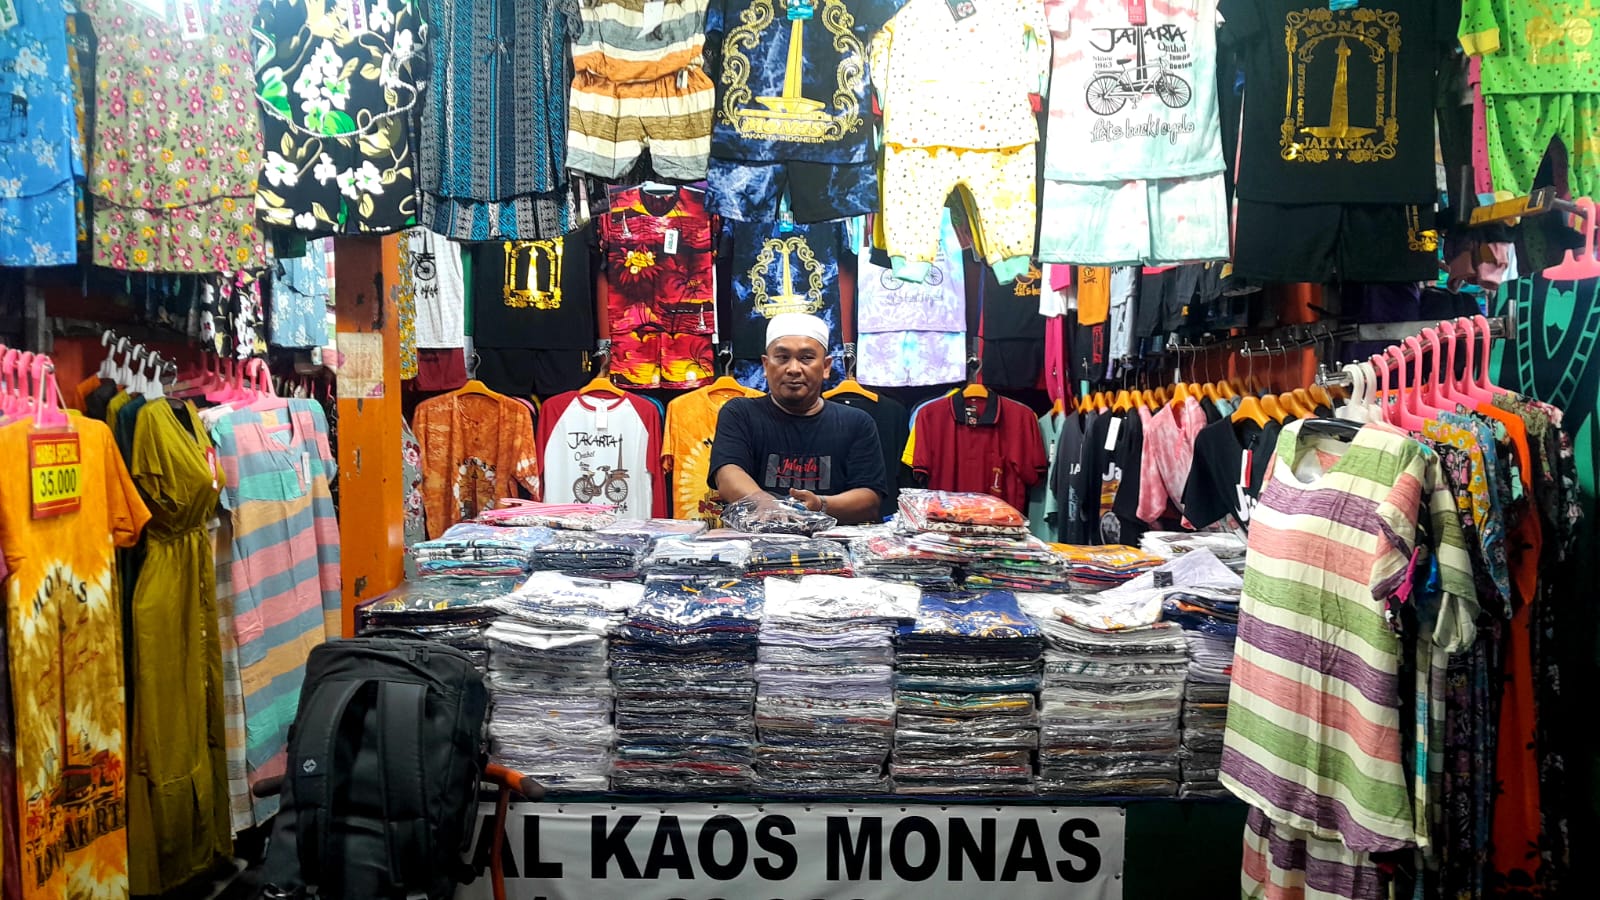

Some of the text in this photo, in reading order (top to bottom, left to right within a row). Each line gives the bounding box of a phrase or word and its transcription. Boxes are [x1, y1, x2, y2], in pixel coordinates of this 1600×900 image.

[1302, 20, 1381, 37] MONAS
[1302, 137, 1377, 149] JAKARTA
[567, 432, 621, 450] JAKARTA
[40, 468, 77, 497] 35.000
[590, 814, 798, 881] KAOS
[826, 815, 1102, 882] MONAS
